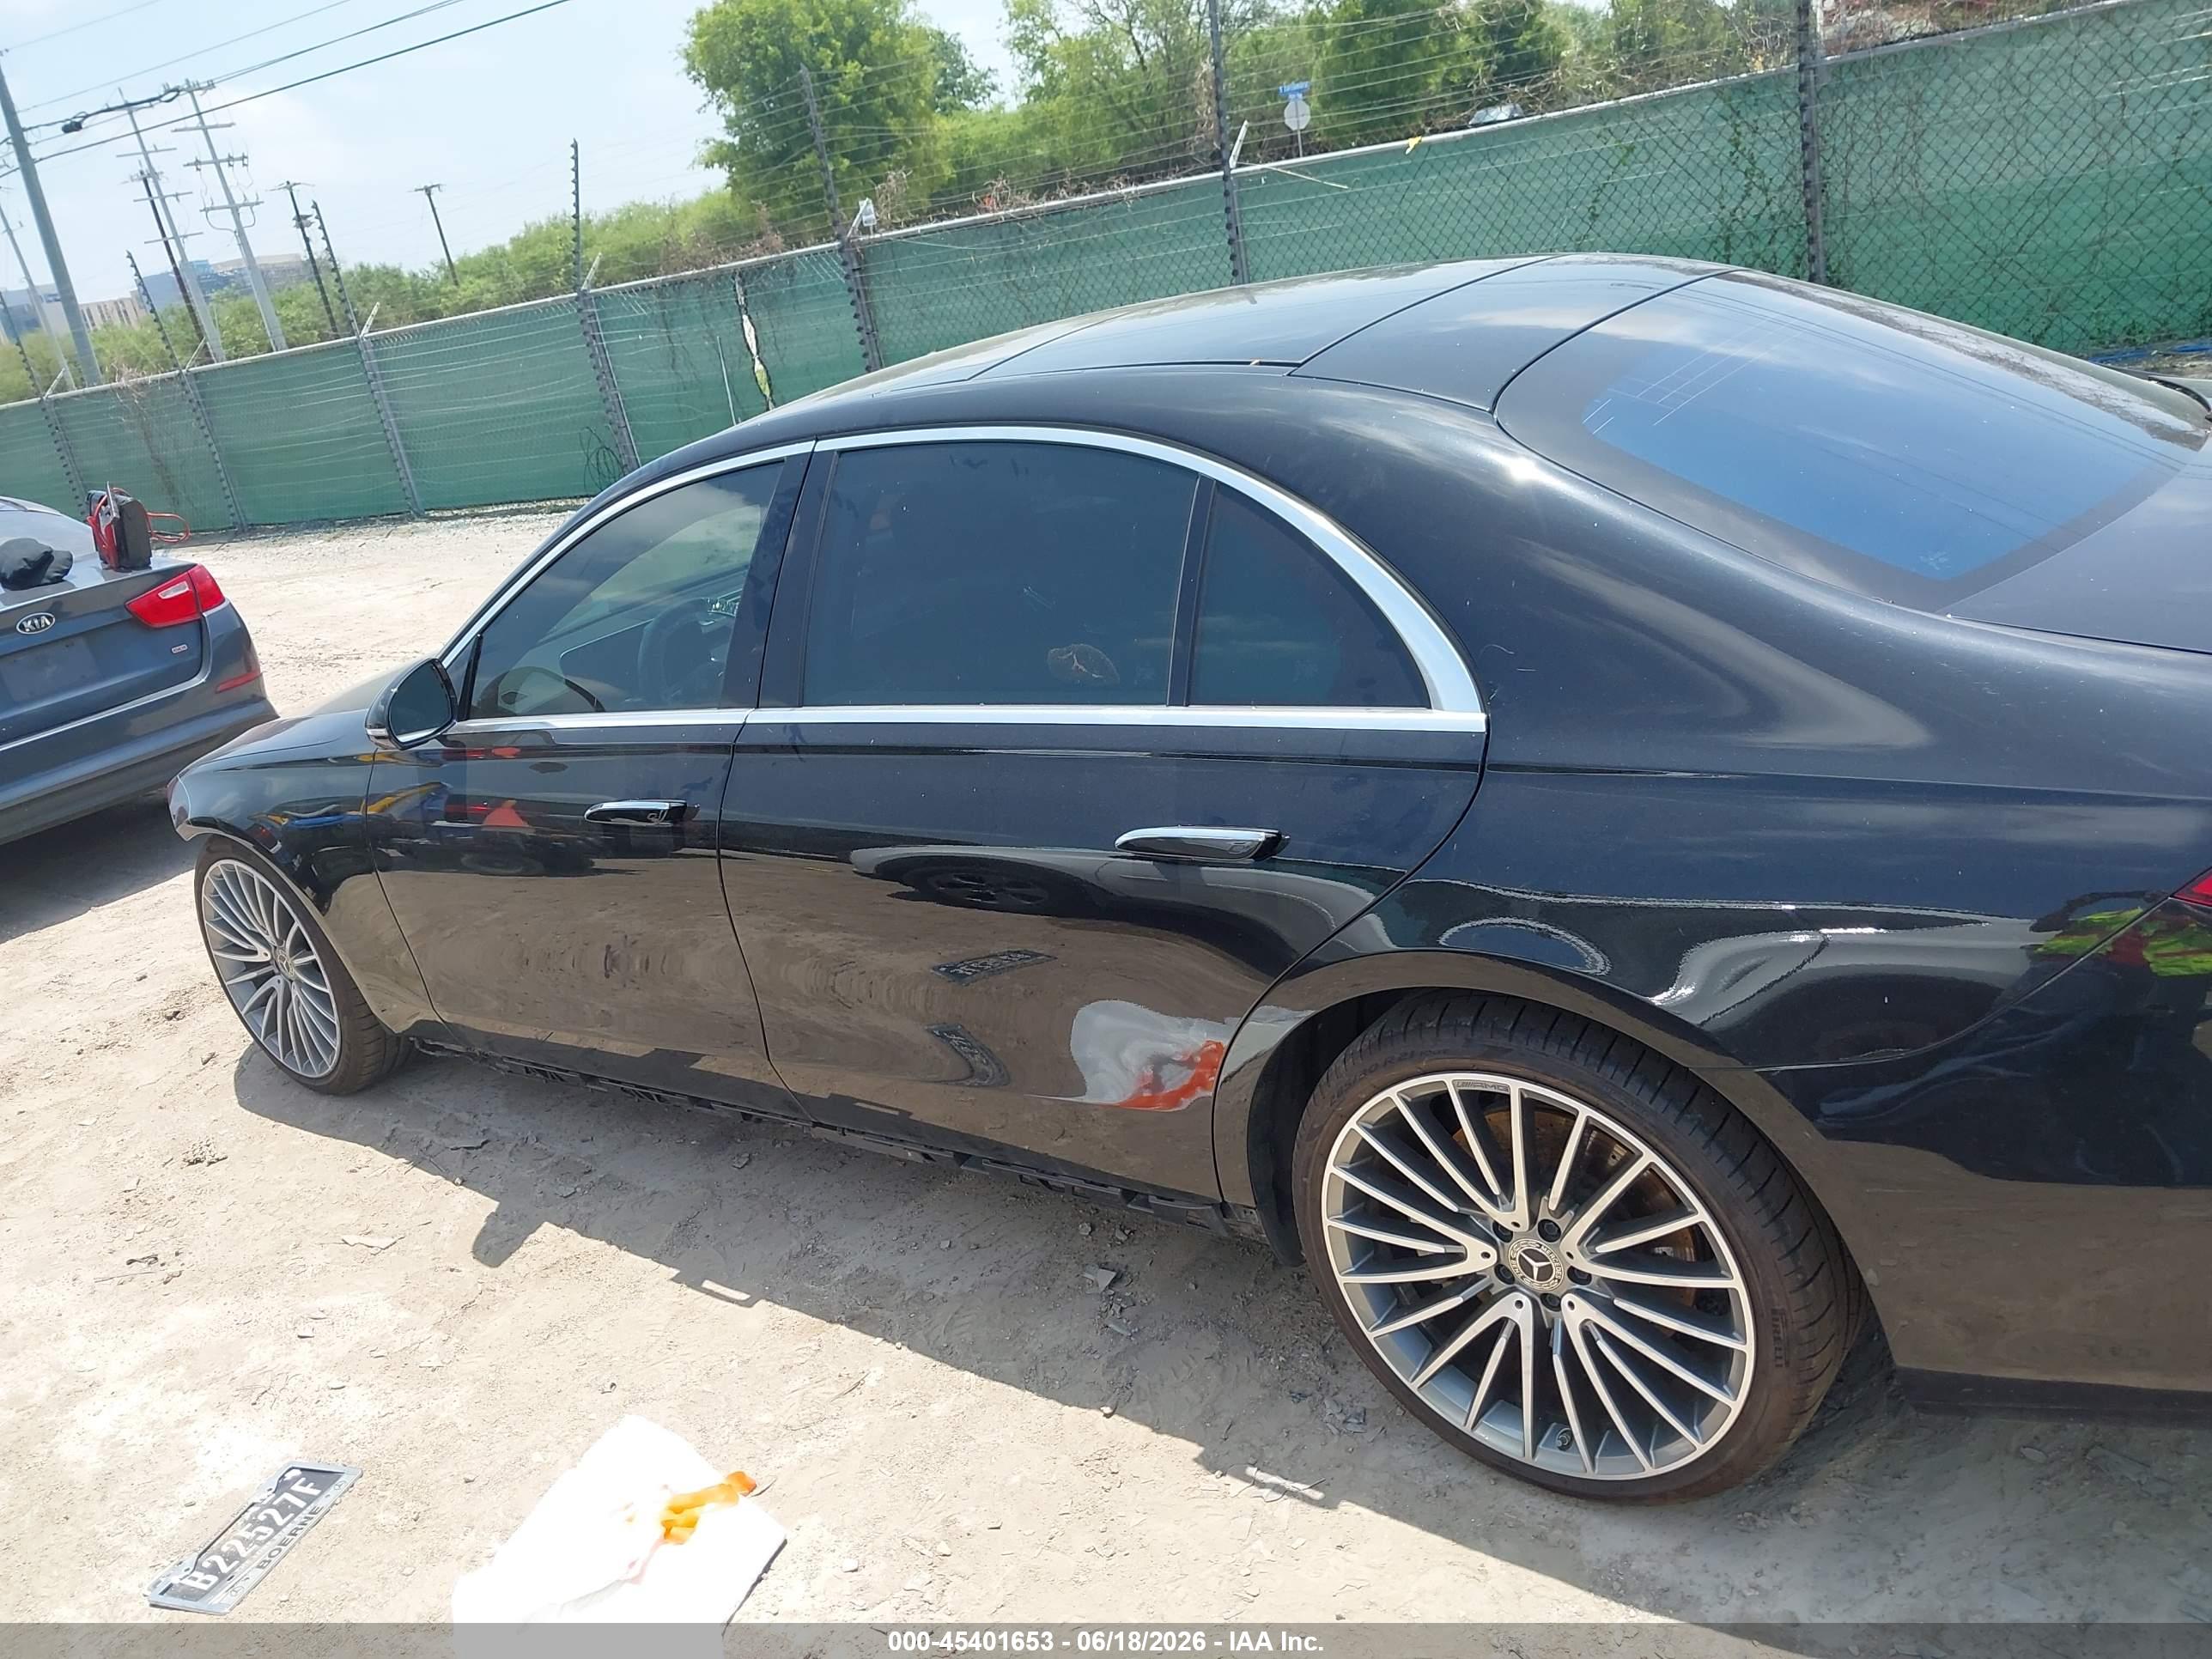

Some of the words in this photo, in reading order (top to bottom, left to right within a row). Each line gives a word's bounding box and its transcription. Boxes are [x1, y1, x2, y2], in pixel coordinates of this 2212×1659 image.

[22, 615, 52, 632] KIA
[1510, 1259, 1524, 1278] BENZ
[1540, 1245, 1563, 1279] MERCEDES
[179, 1477, 323, 1591] B22527F
[256, 1506, 325, 1570] BOERNE
